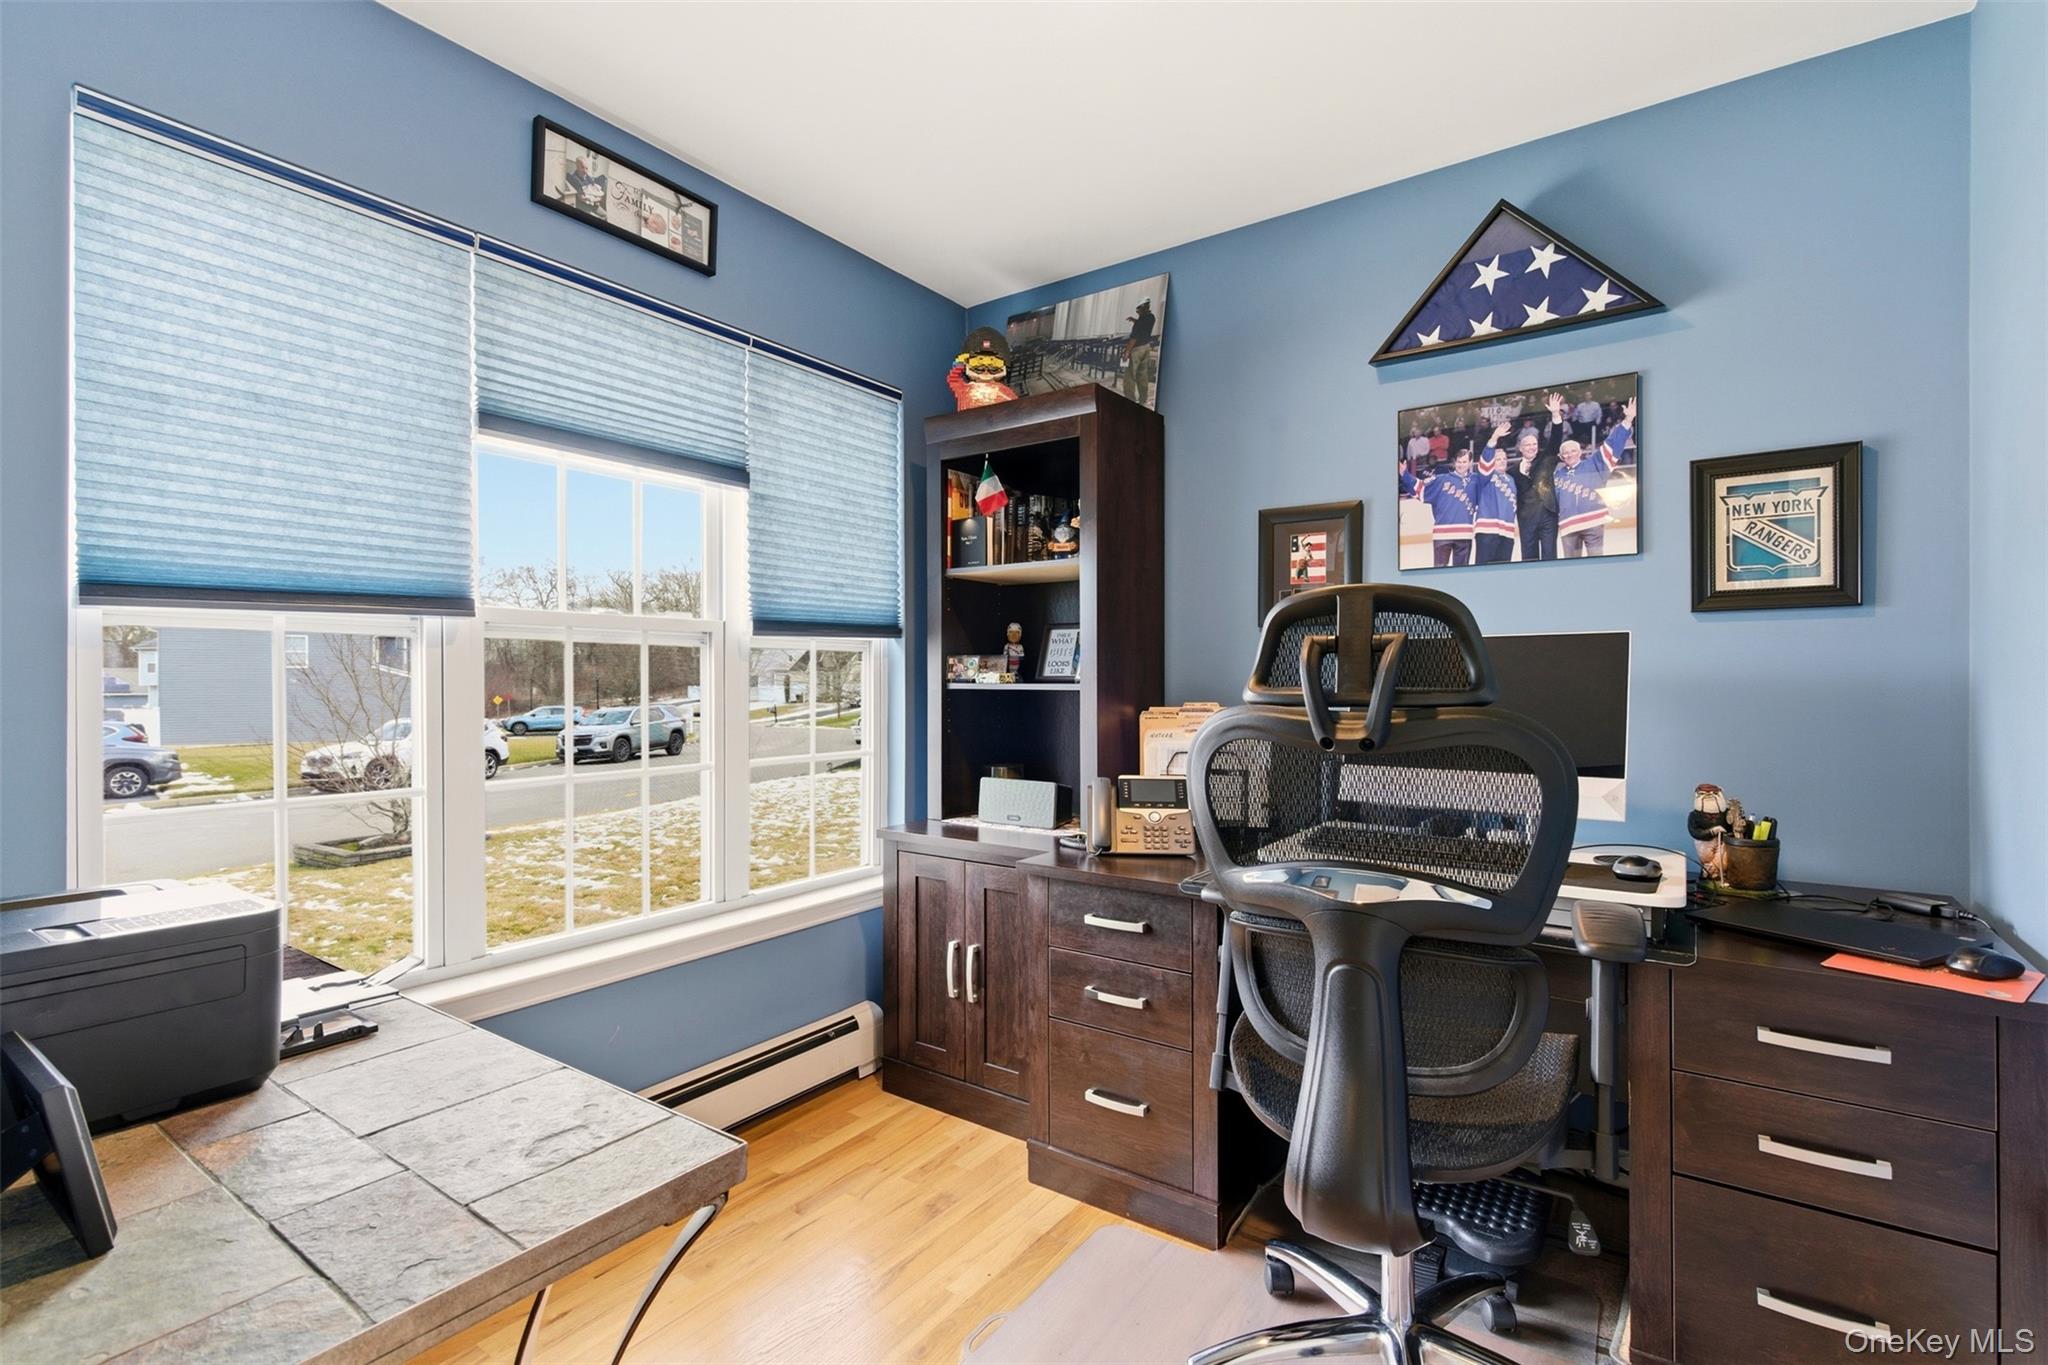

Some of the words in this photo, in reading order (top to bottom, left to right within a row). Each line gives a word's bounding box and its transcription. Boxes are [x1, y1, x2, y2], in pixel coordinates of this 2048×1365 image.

[611, 181, 654, 214] FAMILY
[1732, 502, 1765, 516] NEW
[1772, 498, 1814, 513] YORK
[1744, 521, 1811, 560] RANGERS
